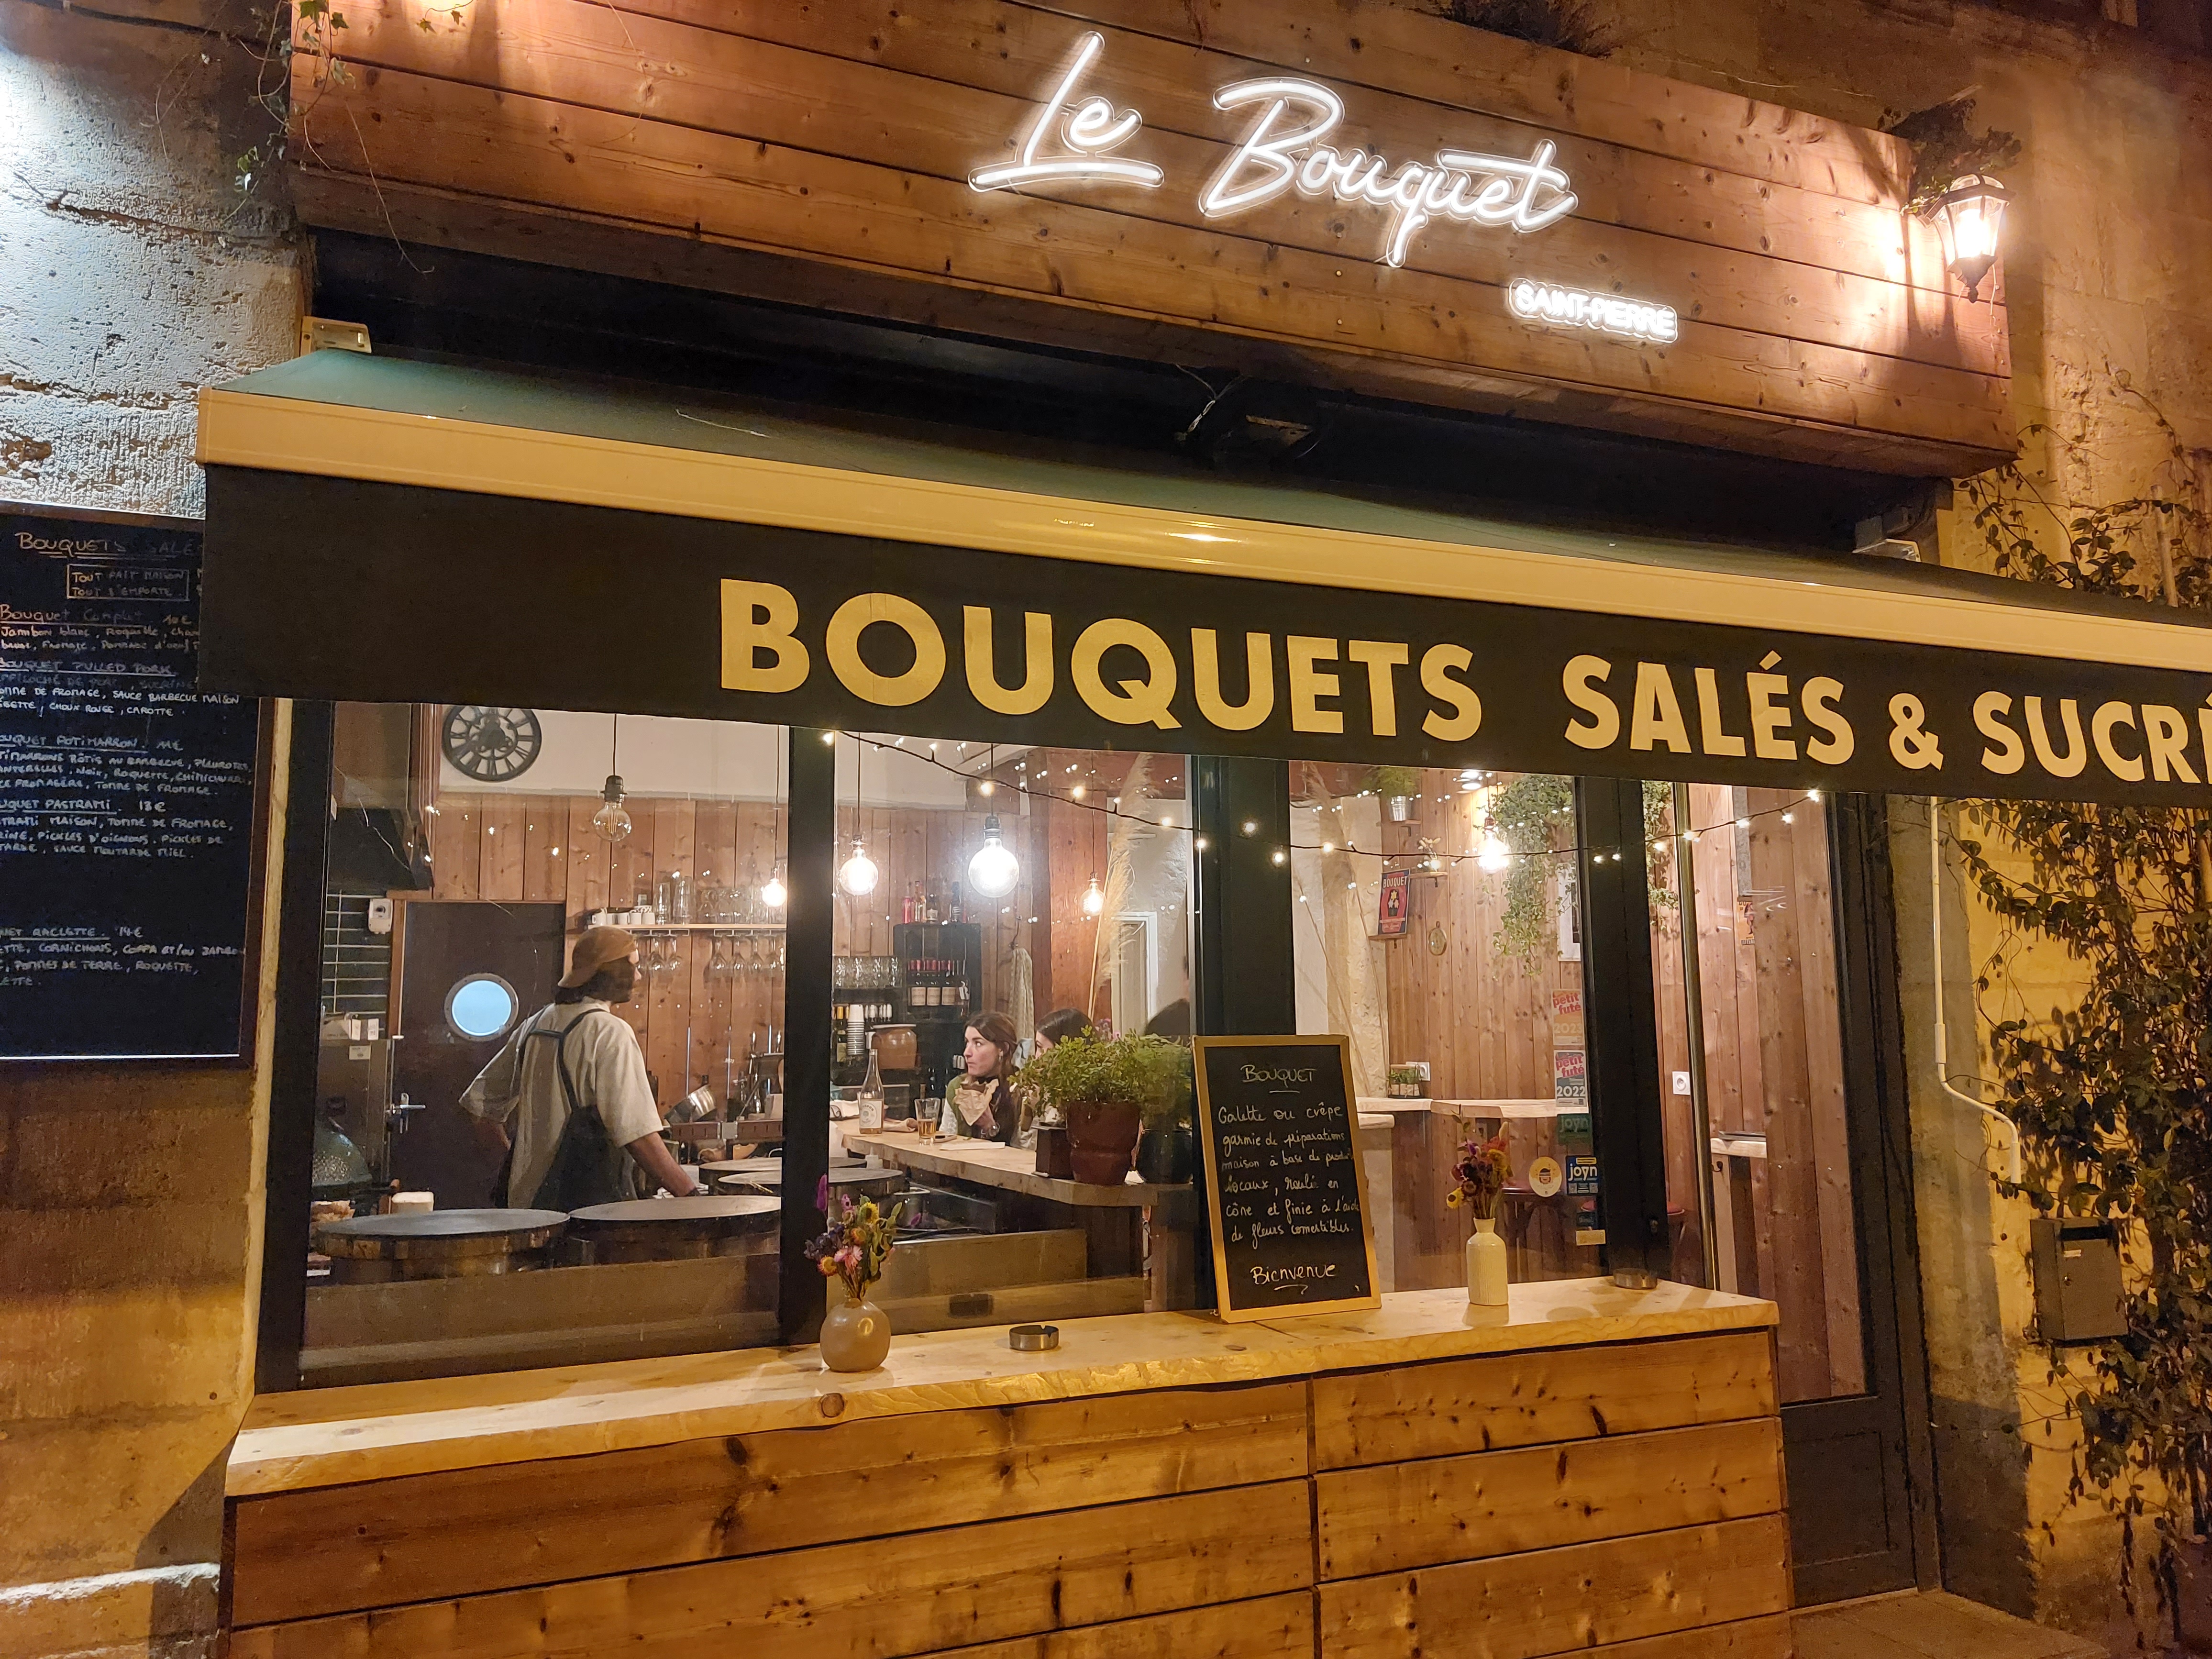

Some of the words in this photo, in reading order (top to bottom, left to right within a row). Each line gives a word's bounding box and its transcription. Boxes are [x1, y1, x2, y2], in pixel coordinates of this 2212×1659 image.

[969, 30, 1163, 190] Le
[1200, 77, 1577, 267] Bouquet
[1515, 284, 1675, 336] SAINT-PIERRE
[14, 532, 126, 557] BOUQUETS
[146, 538, 203, 555] SALÉ
[72, 572, 103, 583] TOUT
[72, 587, 101, 596] TOUT
[0, 604, 70, 623] Bouquet
[1, 626, 51, 637] Jambon
[720, 578, 1482, 742] BOUQUETS
[0, 687, 26, 696] OMME
[34, 687, 47, 696] DE
[112, 690, 142, 701] SAUCE
[147, 692, 198, 702] BARBECUE
[126, 707, 174, 717] CAROTTE
[1562, 650, 1855, 765] SALÉS
[1888, 692, 1944, 771] &
[0, 734, 47, 746] UQUET
[0, 799, 39, 810] UQUET
[0, 815, 39, 826] TRAMI
[1383, 875, 1408, 888] BOUQUET
[201, 946, 245, 957] JAMBO
[1553, 993, 1579, 1008] petit
[1559, 1002, 1581, 1015] futé
[1556, 1055, 1583, 1071] petit
[1240, 1064, 1317, 1087] BOUQUET
[1561, 1065, 1584, 1078] futé
[1557, 1085, 1586, 1097] 2022
[1218, 1105, 1267, 1124] Galette
[1273, 1110, 1295, 1120] ou
[1306, 1102, 1342, 1121] crêpe
[1223, 1133, 1261, 1157] garnie
[1265, 1131, 1278, 1146] de
[1221, 1157, 1259, 1171] maison
[1270, 1155, 1278, 1167] à
[1282, 1150, 1303, 1164] base
[1309, 1148, 1320, 1161] de
[1568, 1163, 1597, 1181] joyn
[1327, 1179, 1339, 1189] en
[1226, 1203, 1252, 1217] cône
[1267, 1207, 1280, 1216] et
[1285, 1198, 1313, 1224] finie
[1321, 1199, 1331, 1213] à
[1231, 1225, 1244, 1242] de
[1252, 1222, 1285, 1250] fleurs
[1250, 1264, 1337, 1285] Bienvenue
